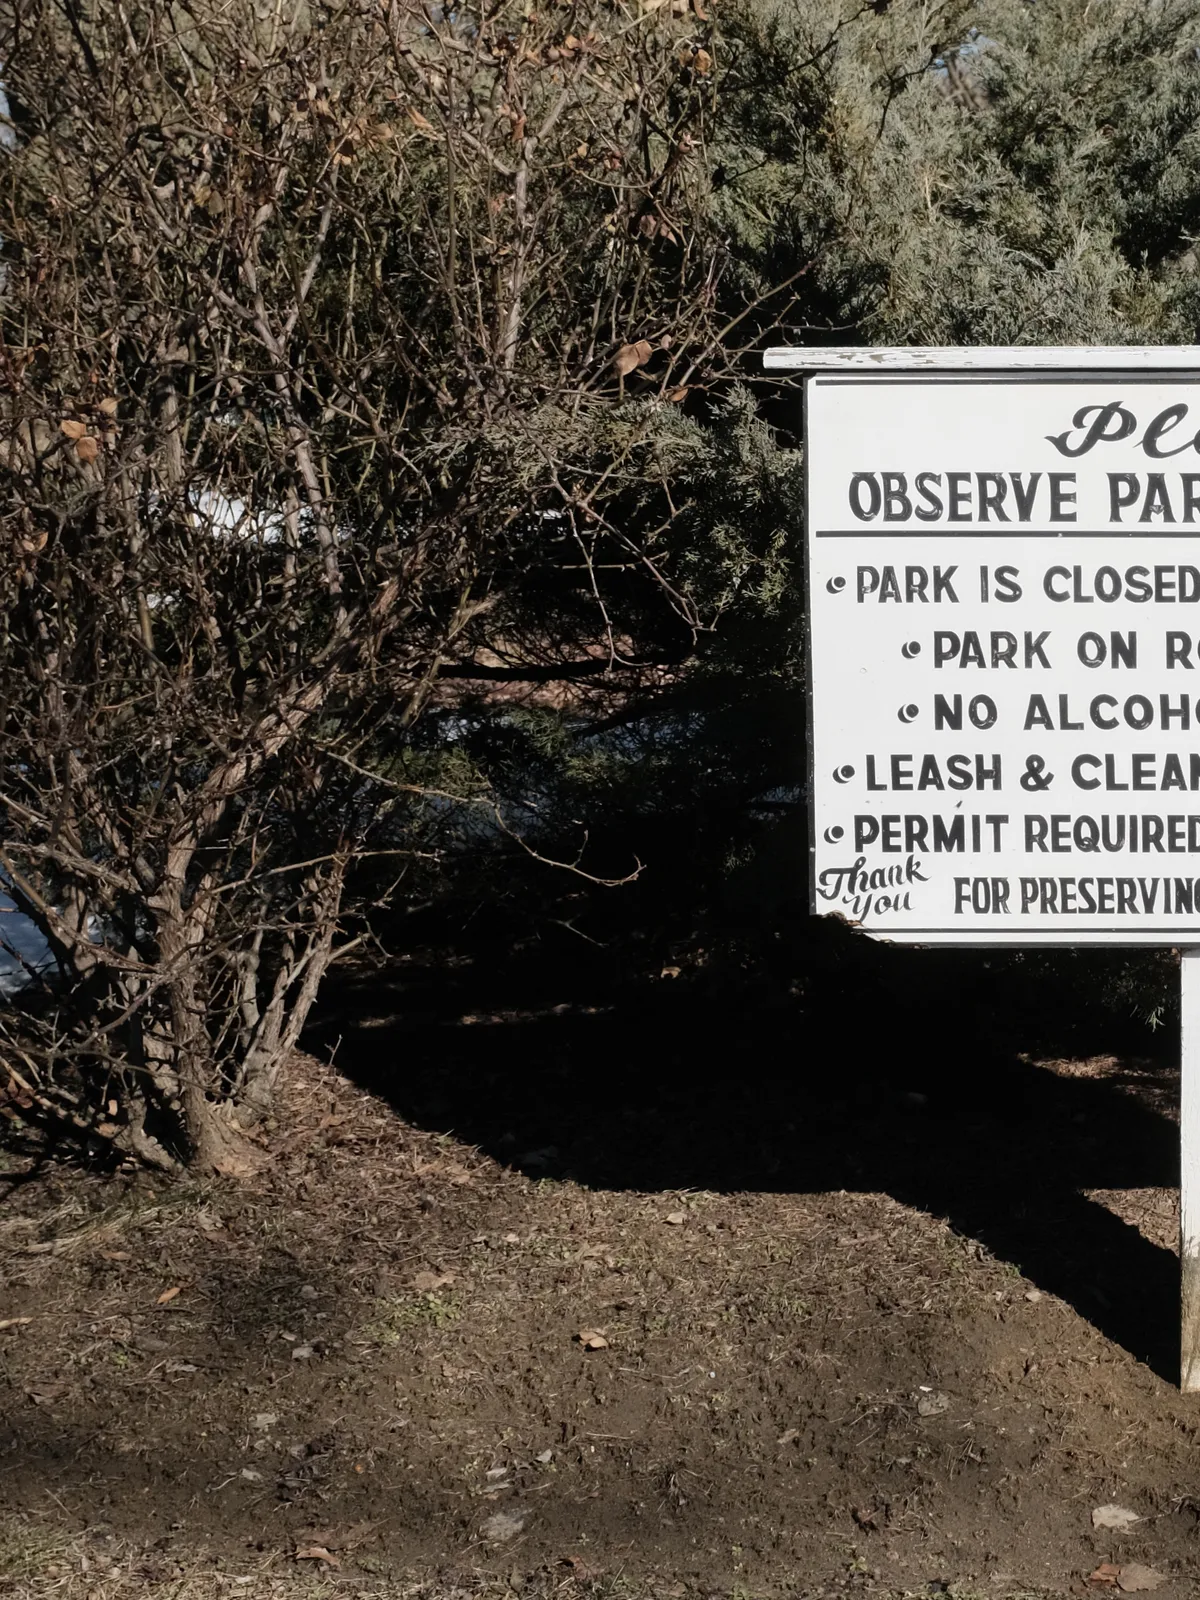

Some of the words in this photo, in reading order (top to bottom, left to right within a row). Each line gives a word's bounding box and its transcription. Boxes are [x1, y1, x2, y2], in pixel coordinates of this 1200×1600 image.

[848, 472, 1077, 522] OBSERVE
[856, 565, 960, 603] PARK
[980, 565, 1022, 603] IS
[933, 631, 1052, 669] PARK
[1077, 631, 1137, 669] ON
[934, 694, 998, 730] NO
[866, 754, 1002, 791] LEASH
[1020, 754, 1055, 792] &
[854, 814, 1009, 853] PERMIT
[816, 854, 931, 900] Thank
[953, 877, 1010, 914] FOR
